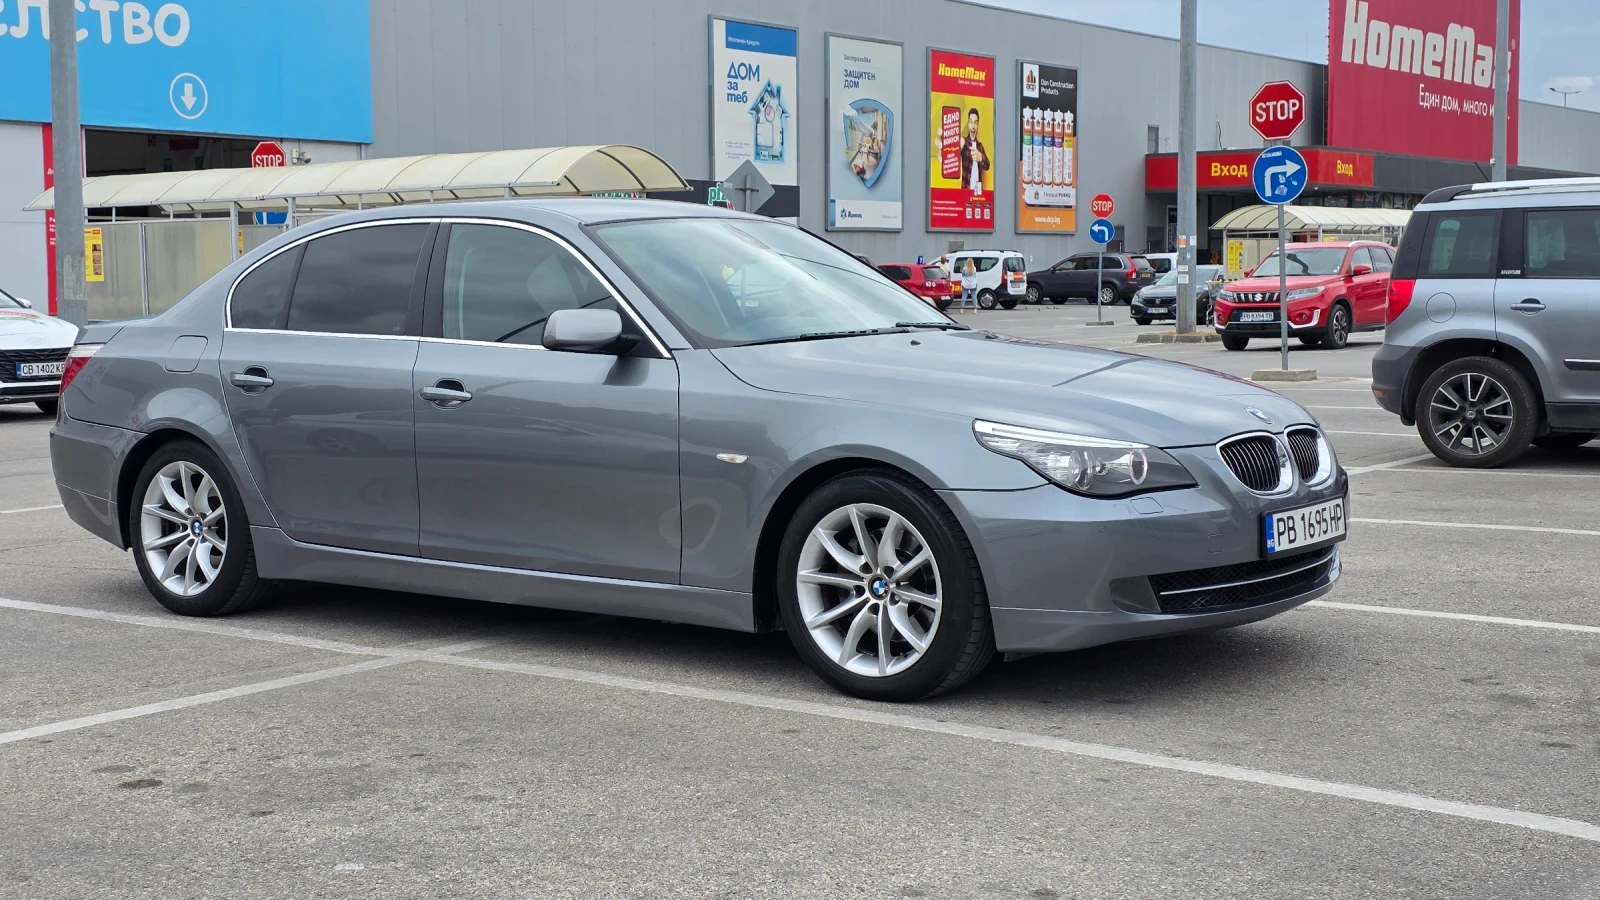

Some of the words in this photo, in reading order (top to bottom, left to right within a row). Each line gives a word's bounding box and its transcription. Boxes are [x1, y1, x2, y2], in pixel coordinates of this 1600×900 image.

[727, 61, 760, 82] ДОМ
[844, 69, 876, 81] ЗАЩИТЕН
[938, 63, 986, 81] HomeMax
[727, 81, 739, 91] за
[844, 80, 859, 89] ДОМ
[1050, 79, 1074, 89] Construction
[727, 91, 748, 104] теб
[1041, 87, 1059, 96] Products
[1419, 83, 1440, 109] Един
[1442, 95, 1460, 116] дом,
[1463, 102, 1488, 116] много
[1256, 99, 1299, 122] STOP
[943, 112, 960, 125] ЕДНО
[255, 154, 283, 168] STOP
[1211, 162, 1248, 178] Вход
[1337, 160, 1353, 177] Вход
[1093, 201, 1113, 211] STOP
[22, 365, 34, 375] CB
[36, 364, 55, 374] 1402
[1276, 515, 1297, 547] PB
[1300, 507, 1329, 541] 1695
[1329, 503, 1342, 533] HP
